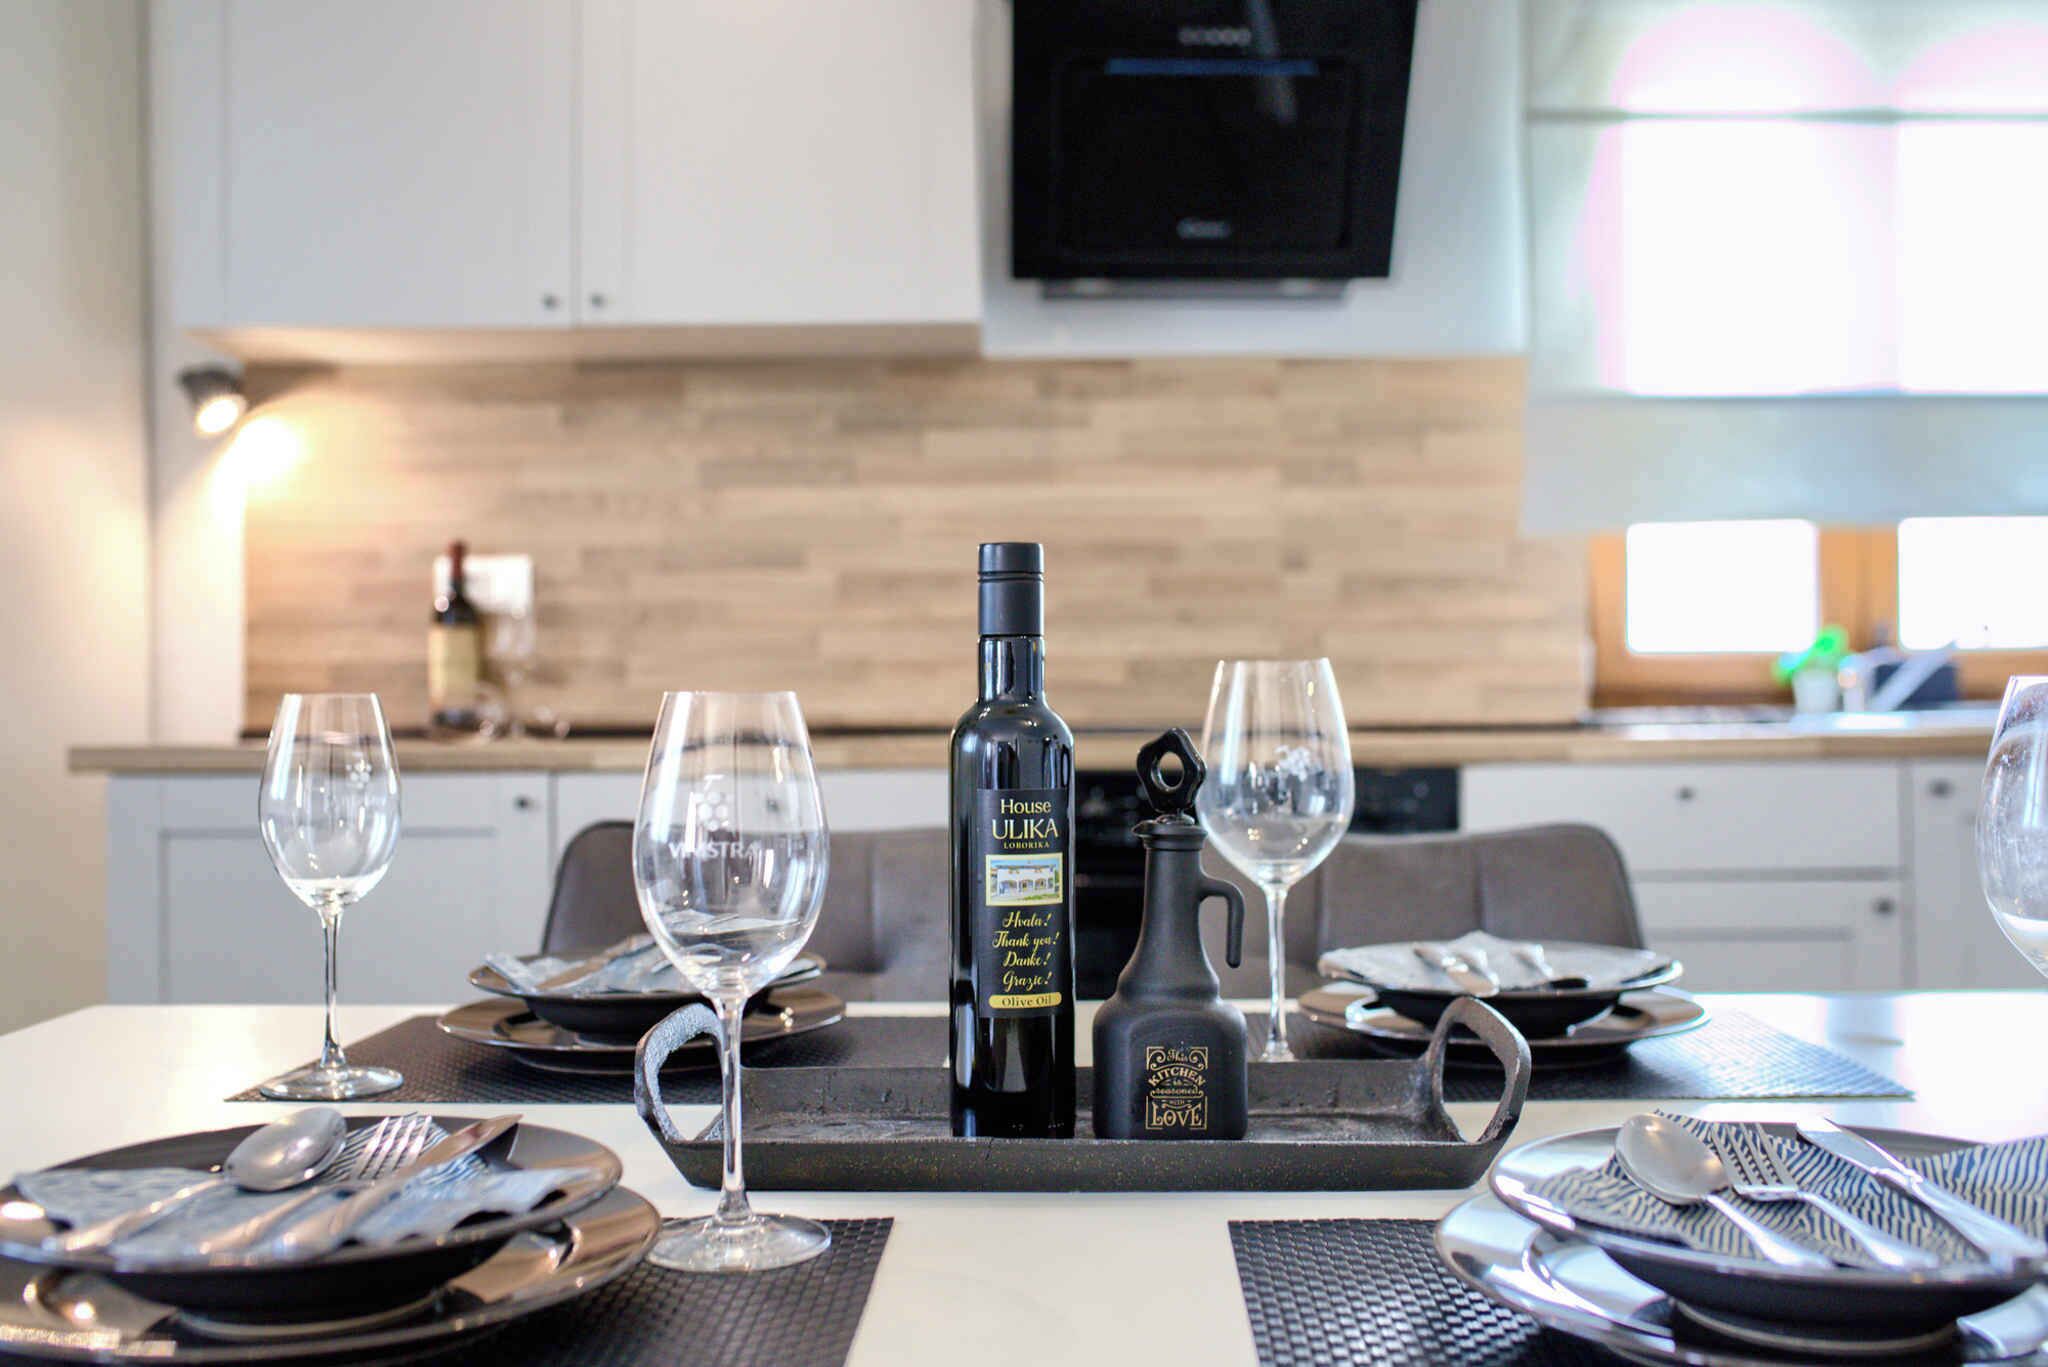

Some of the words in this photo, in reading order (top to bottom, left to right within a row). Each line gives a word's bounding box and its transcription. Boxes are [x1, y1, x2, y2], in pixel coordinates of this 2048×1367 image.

[1000, 799, 1052, 814] House
[992, 818, 1059, 840] ULIKA
[992, 930, 1030, 948] Thank
[1002, 996, 1033, 1007] Olive
[1036, 994, 1052, 1006] Oil
[1148, 1067, 1206, 1086] KITCHEN
[1152, 1102, 1202, 1126] LOVE
